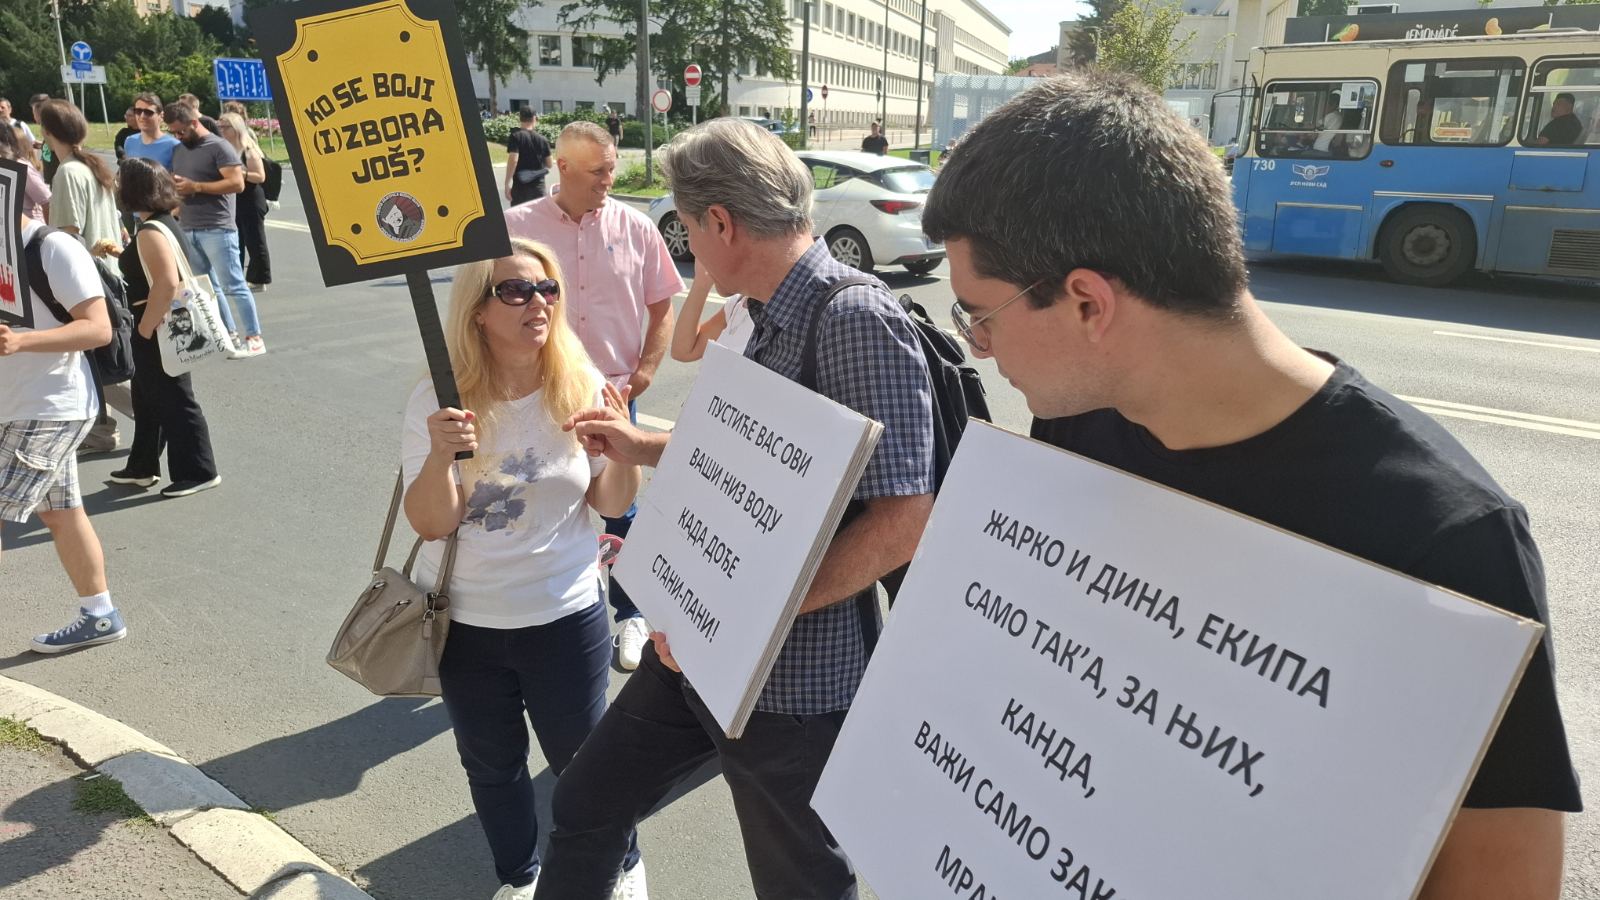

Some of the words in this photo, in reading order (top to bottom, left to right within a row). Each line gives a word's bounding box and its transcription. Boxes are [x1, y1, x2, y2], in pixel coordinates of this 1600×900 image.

[304, 94, 336, 126] KO
[332, 76, 369, 110] SE
[373, 72, 435, 102] BOJI
[313, 107, 445, 156] (I)ZBORA
[352, 143, 425, 184] JOŠ?
[1253, 160, 1276, 171] 730
[707, 395, 759, 442] ПУСТИЋЕ
[755, 425, 783, 458] ВАС
[780, 442, 813, 478] ОВИ
[688, 447, 721, 487] ВАШИ
[720, 471, 747, 505] НИЗ
[743, 490, 783, 535] ВОДУ
[677, 506, 708, 549] КАДА
[702, 534, 741, 580] ДОЂЕ
[652, 553, 722, 643] СТАНИ-ПАНИ!
[983, 509, 1065, 568] ЖАРКО
[1065, 549, 1091, 582] И
[1086, 563, 1185, 640] ДИНА,
[1196, 613, 1331, 709] ЕКИПА
[965, 581, 1028, 637] САМО
[1116, 675, 1159, 726] ЗА
[1164, 703, 1265, 798] ЊИХ,
[1000, 697, 1096, 799] КАНДА,
[914, 720, 976, 793] ВАЖИ
[974, 778, 1050, 861] САМО
[1050, 847, 1124, 900] ЗАК
[934, 844, 997, 900] МРА
